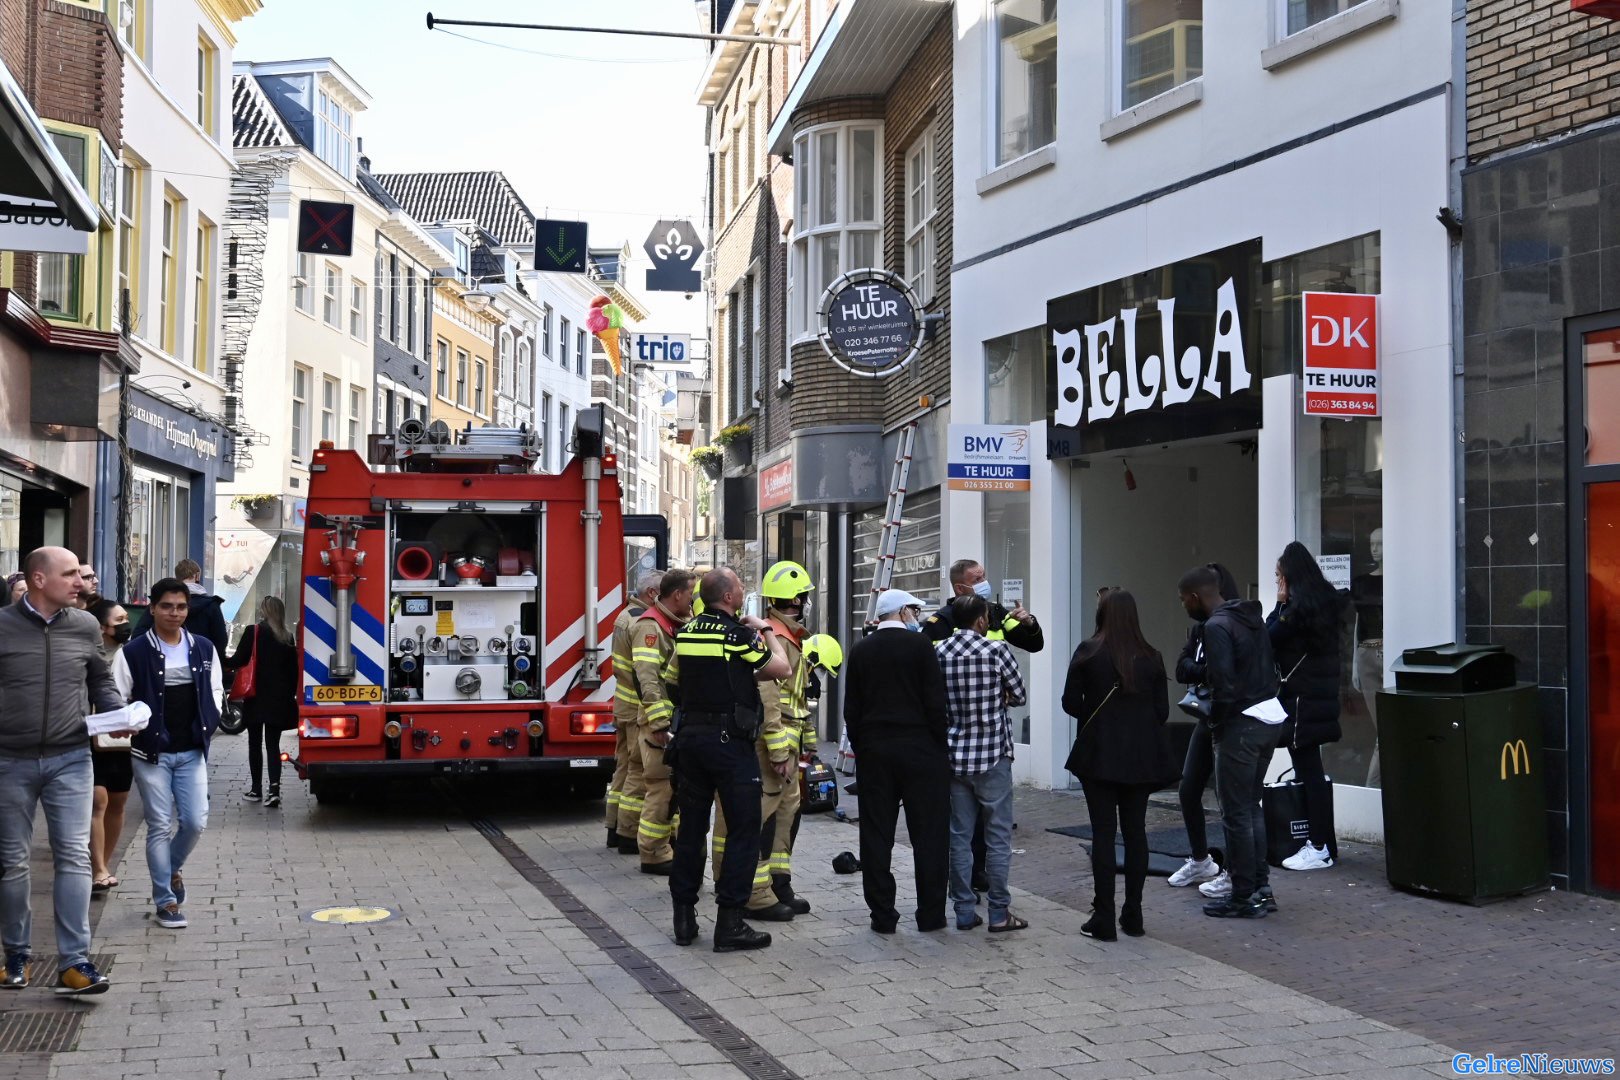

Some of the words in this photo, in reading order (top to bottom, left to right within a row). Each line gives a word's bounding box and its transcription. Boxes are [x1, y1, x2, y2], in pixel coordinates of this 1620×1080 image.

[855, 285, 880, 302] TE
[842, 300, 898, 320] HUUR
[835, 326, 846, 335] Ca.
[868, 322, 908, 330] winkelruimte
[1311, 315, 1370, 348] DK
[636, 335, 684, 360] trio
[844, 338, 861, 347] 020
[863, 336, 879, 345] 346
[880, 335, 889, 343] 77
[891, 334, 902, 342] 66
[1053, 276, 1251, 427] BELLA
[1305, 373, 1326, 386] TE
[1330, 374, 1376, 388] HUUR
[1308, 399, 1329, 410] (026)
[1330, 400, 1348, 409] 363
[1348, 401, 1362, 410] 84
[1362, 401, 1375, 410] 94
[964, 436, 1003, 453] BMV
[964, 465, 978, 477] TE
[981, 466, 1014, 477] HUUR
[317, 687, 378, 699] 60-BDF-6
